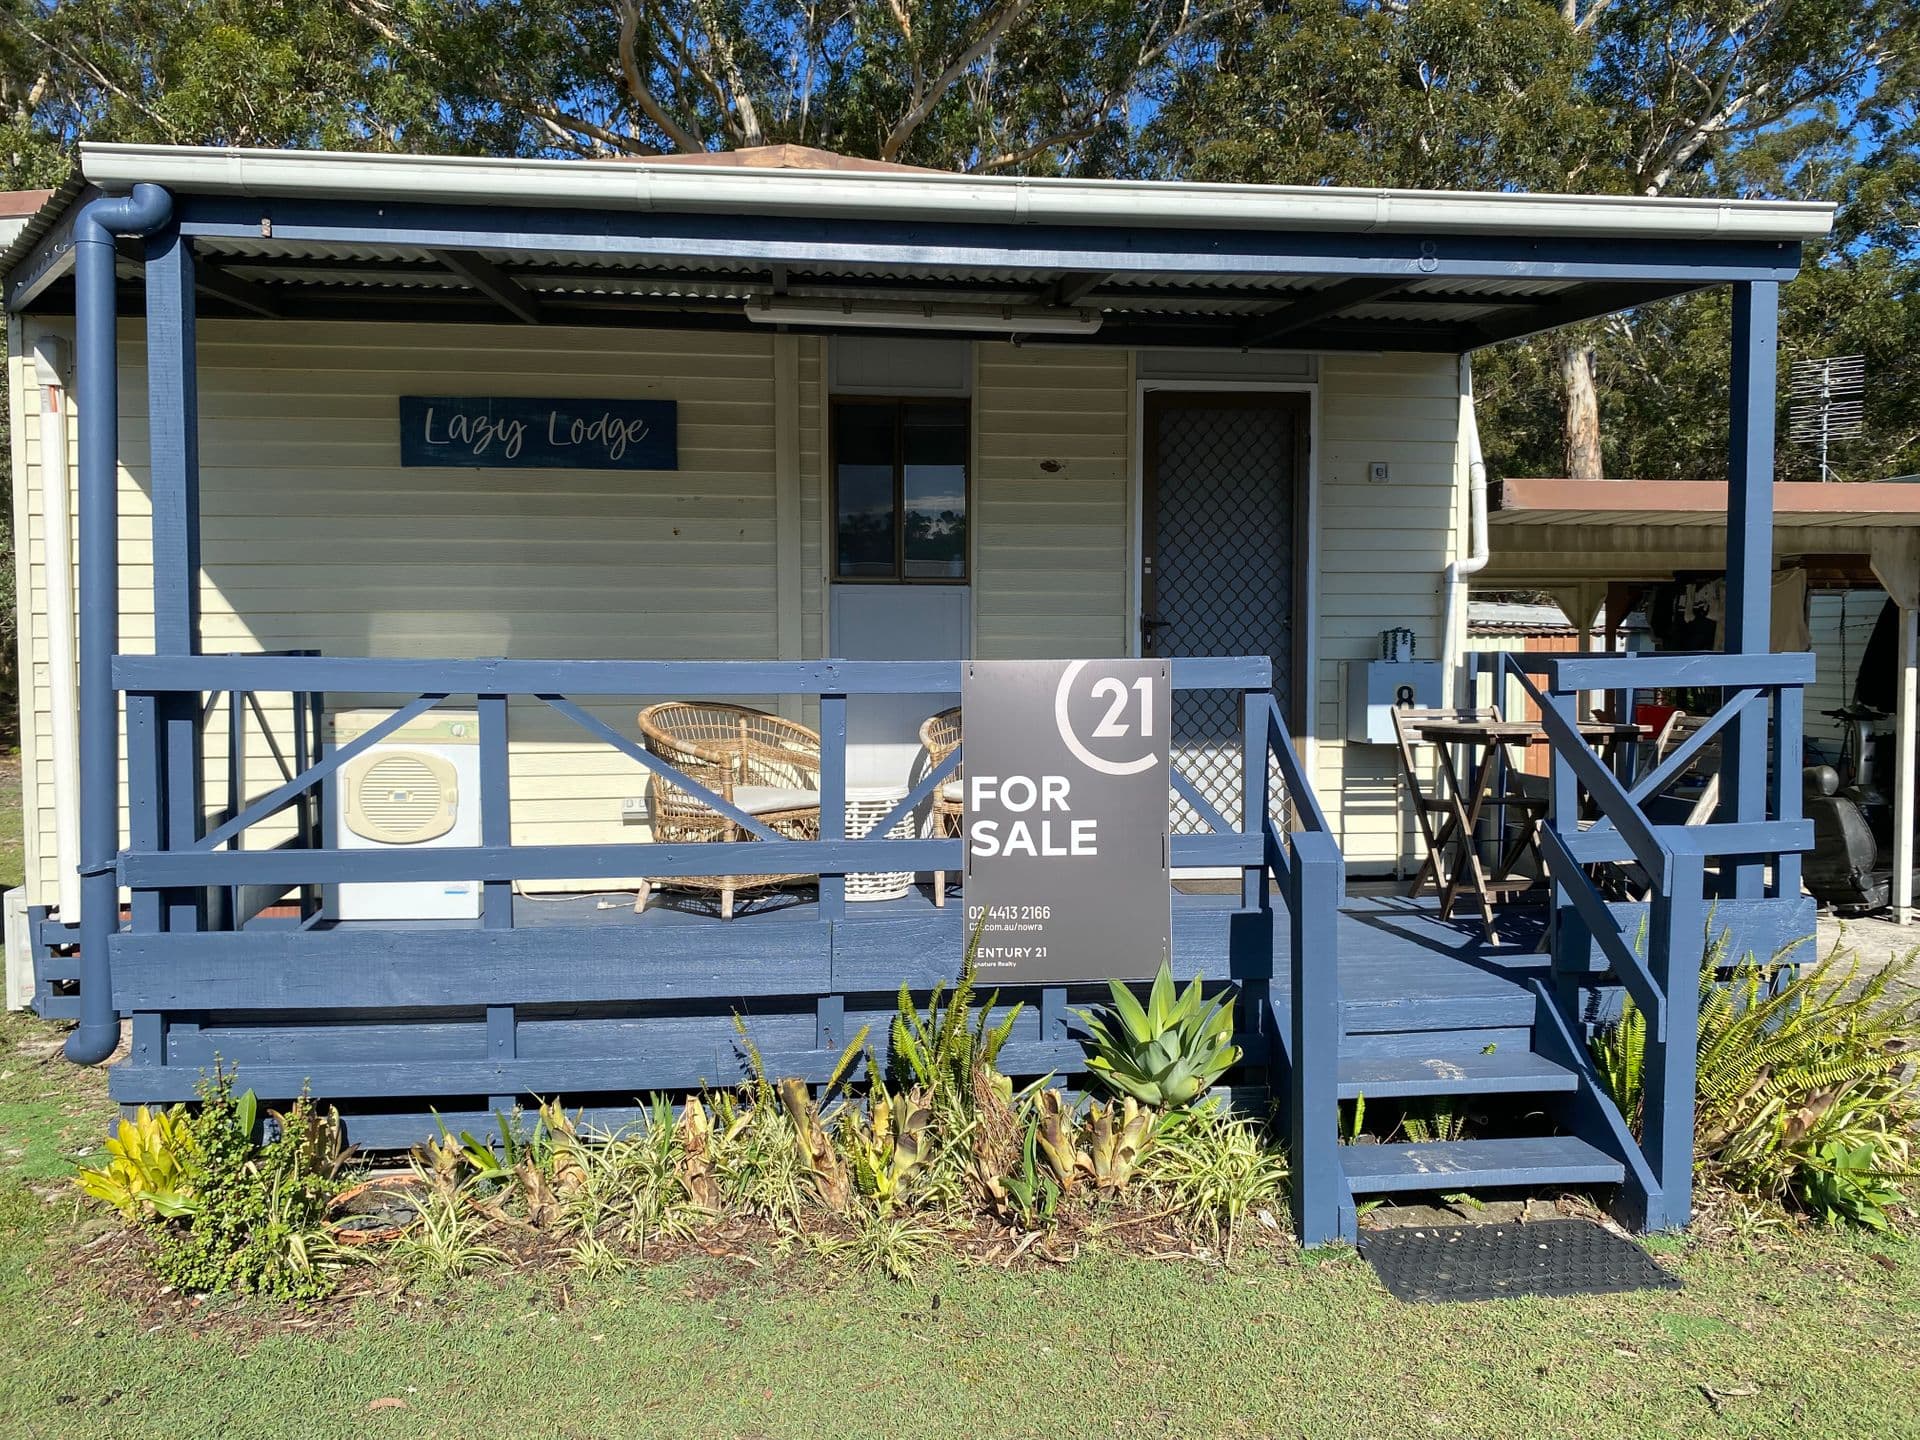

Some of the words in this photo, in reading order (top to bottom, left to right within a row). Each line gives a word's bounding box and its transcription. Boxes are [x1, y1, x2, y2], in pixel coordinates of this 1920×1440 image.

[425, 407, 527, 459] Lazy
[548, 410, 649, 461] Lodge
[1396, 685, 1415, 709] 8
[971, 775, 1071, 812] FOR
[970, 819, 1098, 857] SALE
[988, 905, 1018, 920] 4413
[1021, 905, 1051, 920] 2166
[973, 947, 1032, 959] ENTURY
[1035, 947, 1047, 958] 21
